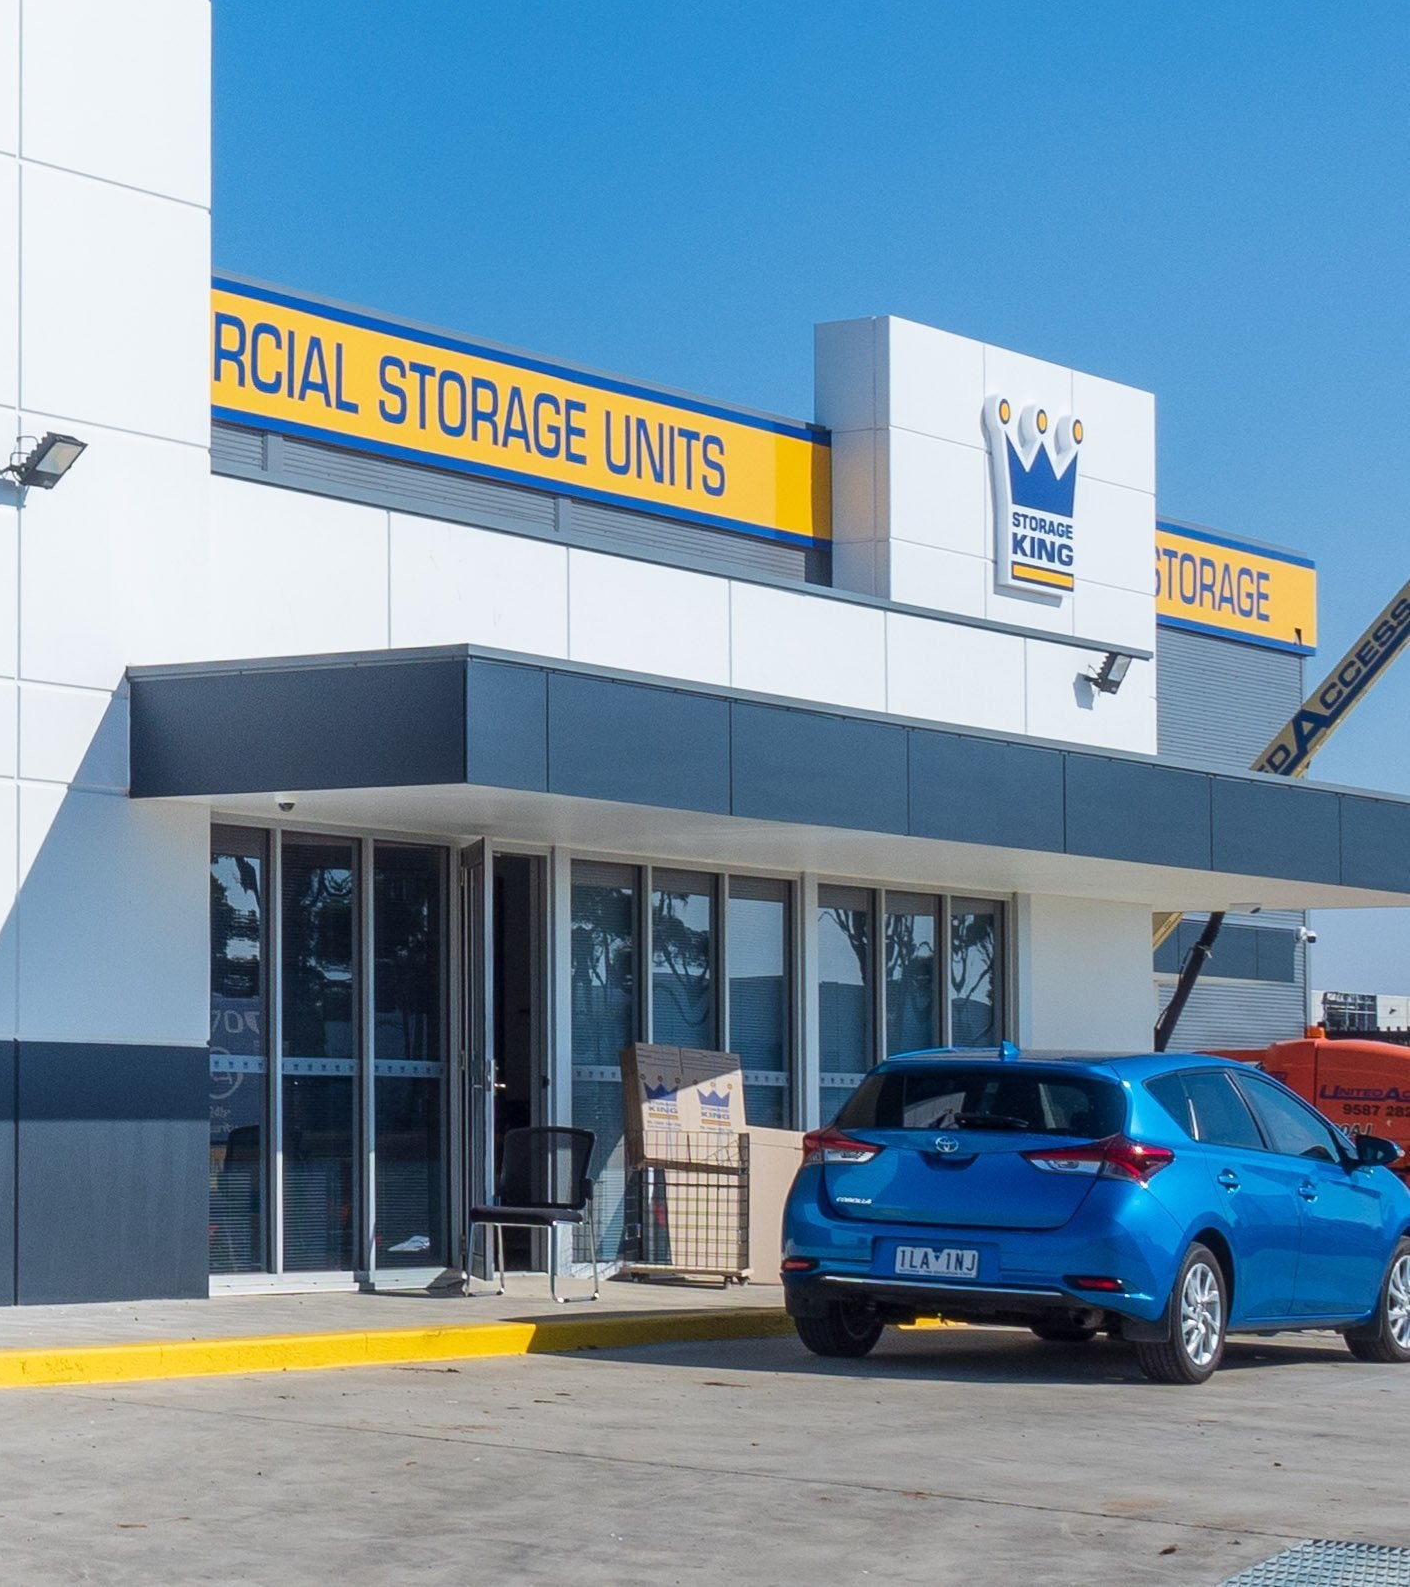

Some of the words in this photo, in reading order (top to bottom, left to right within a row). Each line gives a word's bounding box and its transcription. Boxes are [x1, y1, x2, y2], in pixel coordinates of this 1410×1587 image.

[379, 355, 588, 465] STORAGE
[605, 409, 726, 497] UNITS
[1012, 512, 1073, 540] STORAGE
[1012, 532, 1073, 566] KING
[648, 1106, 678, 1114] KING
[701, 1111, 730, 1120] KING
[1343, 1104, 1380, 1116] 9587
[900, 1250, 930, 1269] 1LA
[946, 1252, 976, 1272] 1NJ
